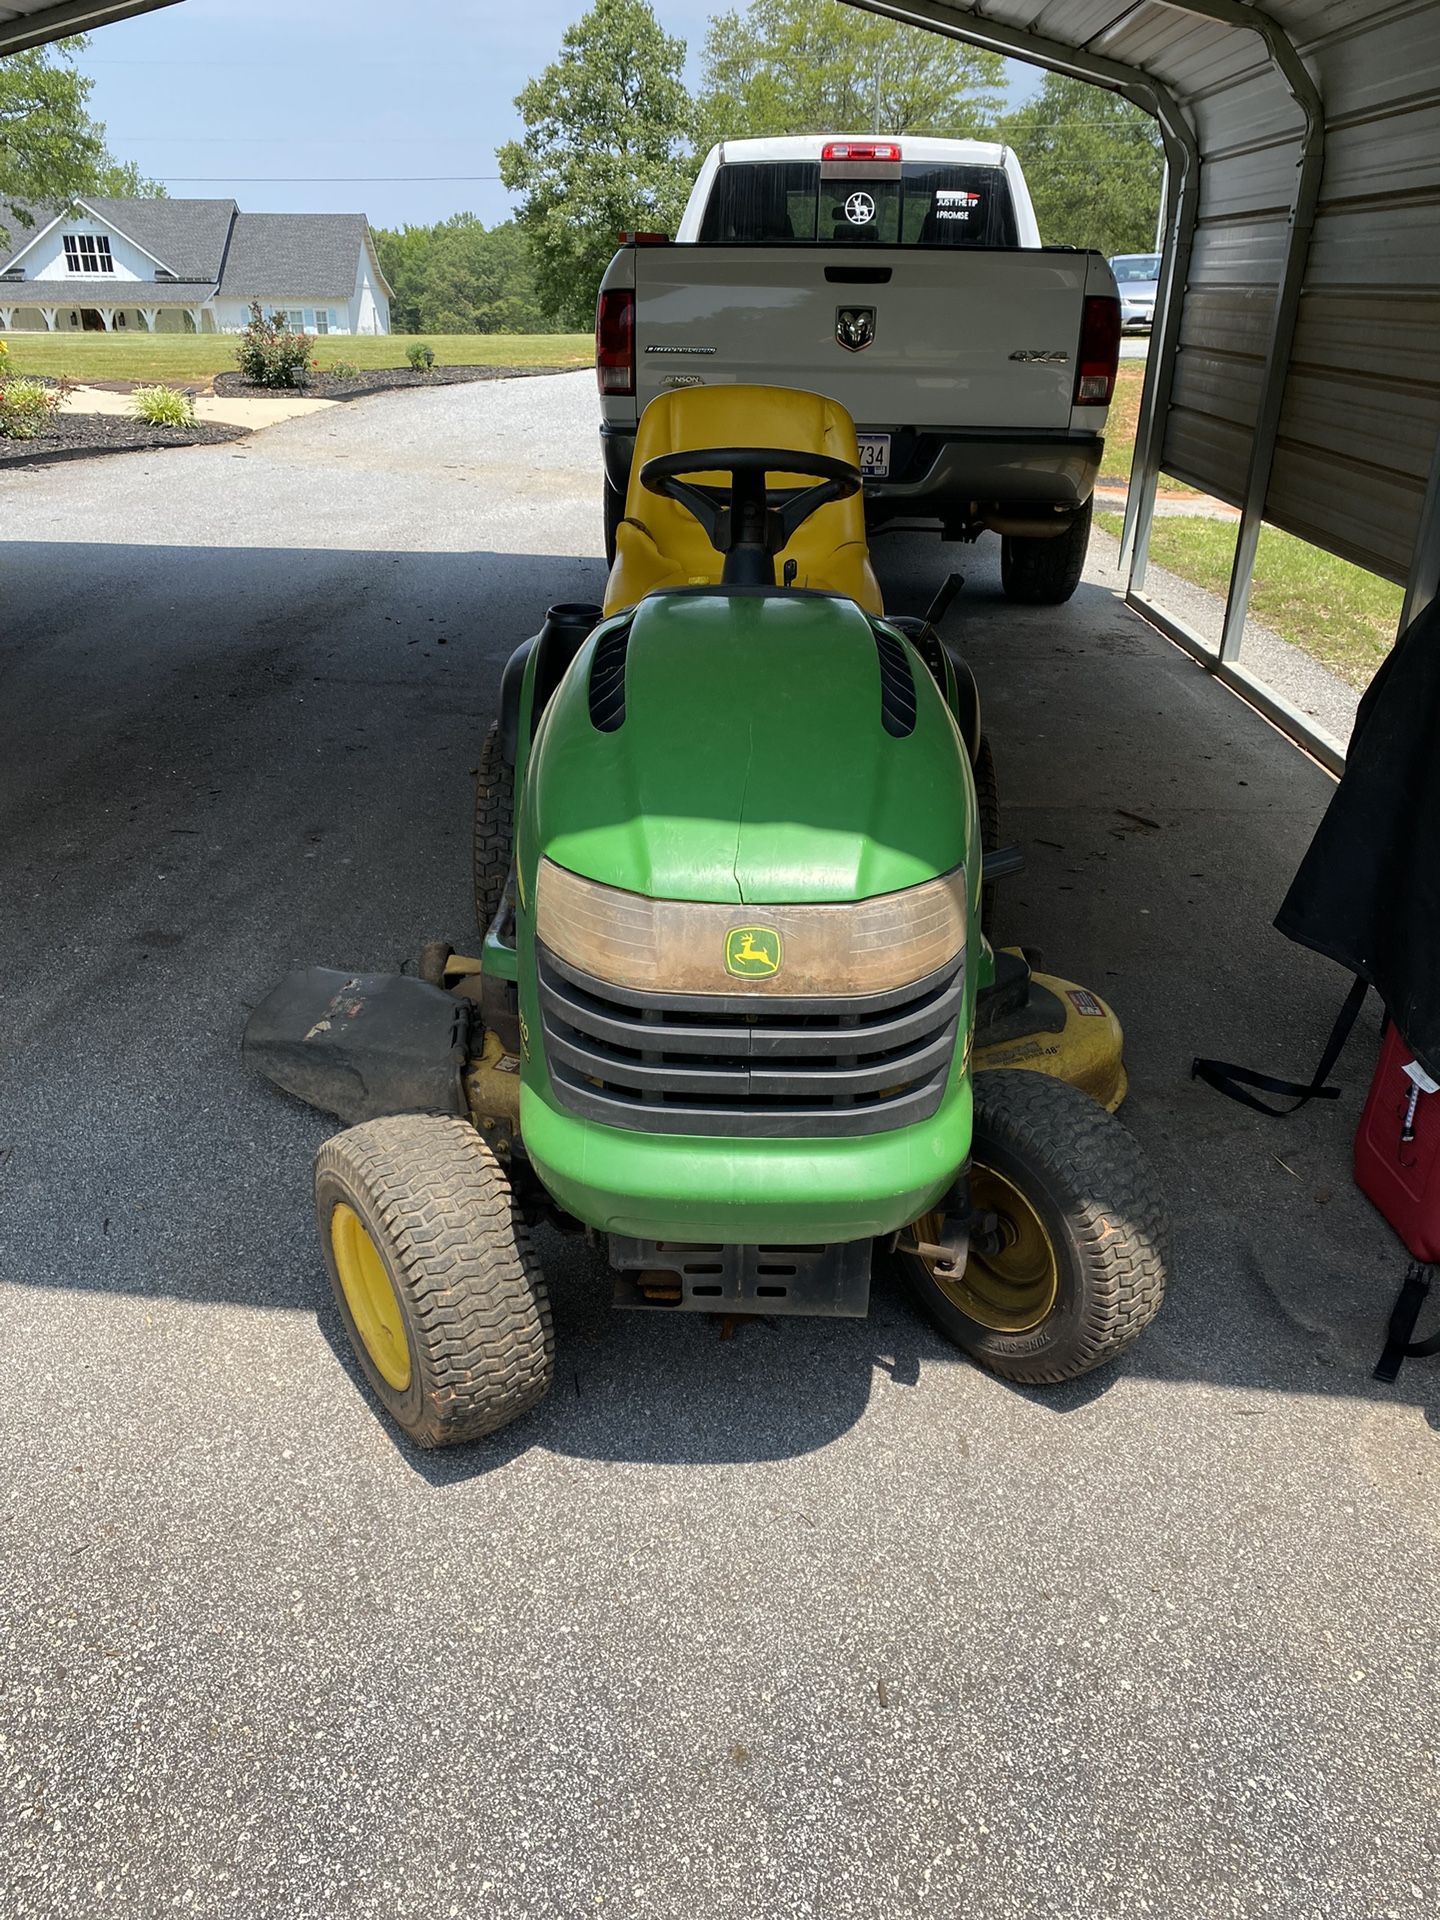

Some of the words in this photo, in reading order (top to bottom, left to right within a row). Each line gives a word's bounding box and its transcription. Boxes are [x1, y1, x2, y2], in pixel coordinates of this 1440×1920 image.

[954, 199, 967, 207] THE
[967, 199, 979, 207] TIP
[940, 211, 969, 220] PROMISE
[858, 445, 884, 465] 734
